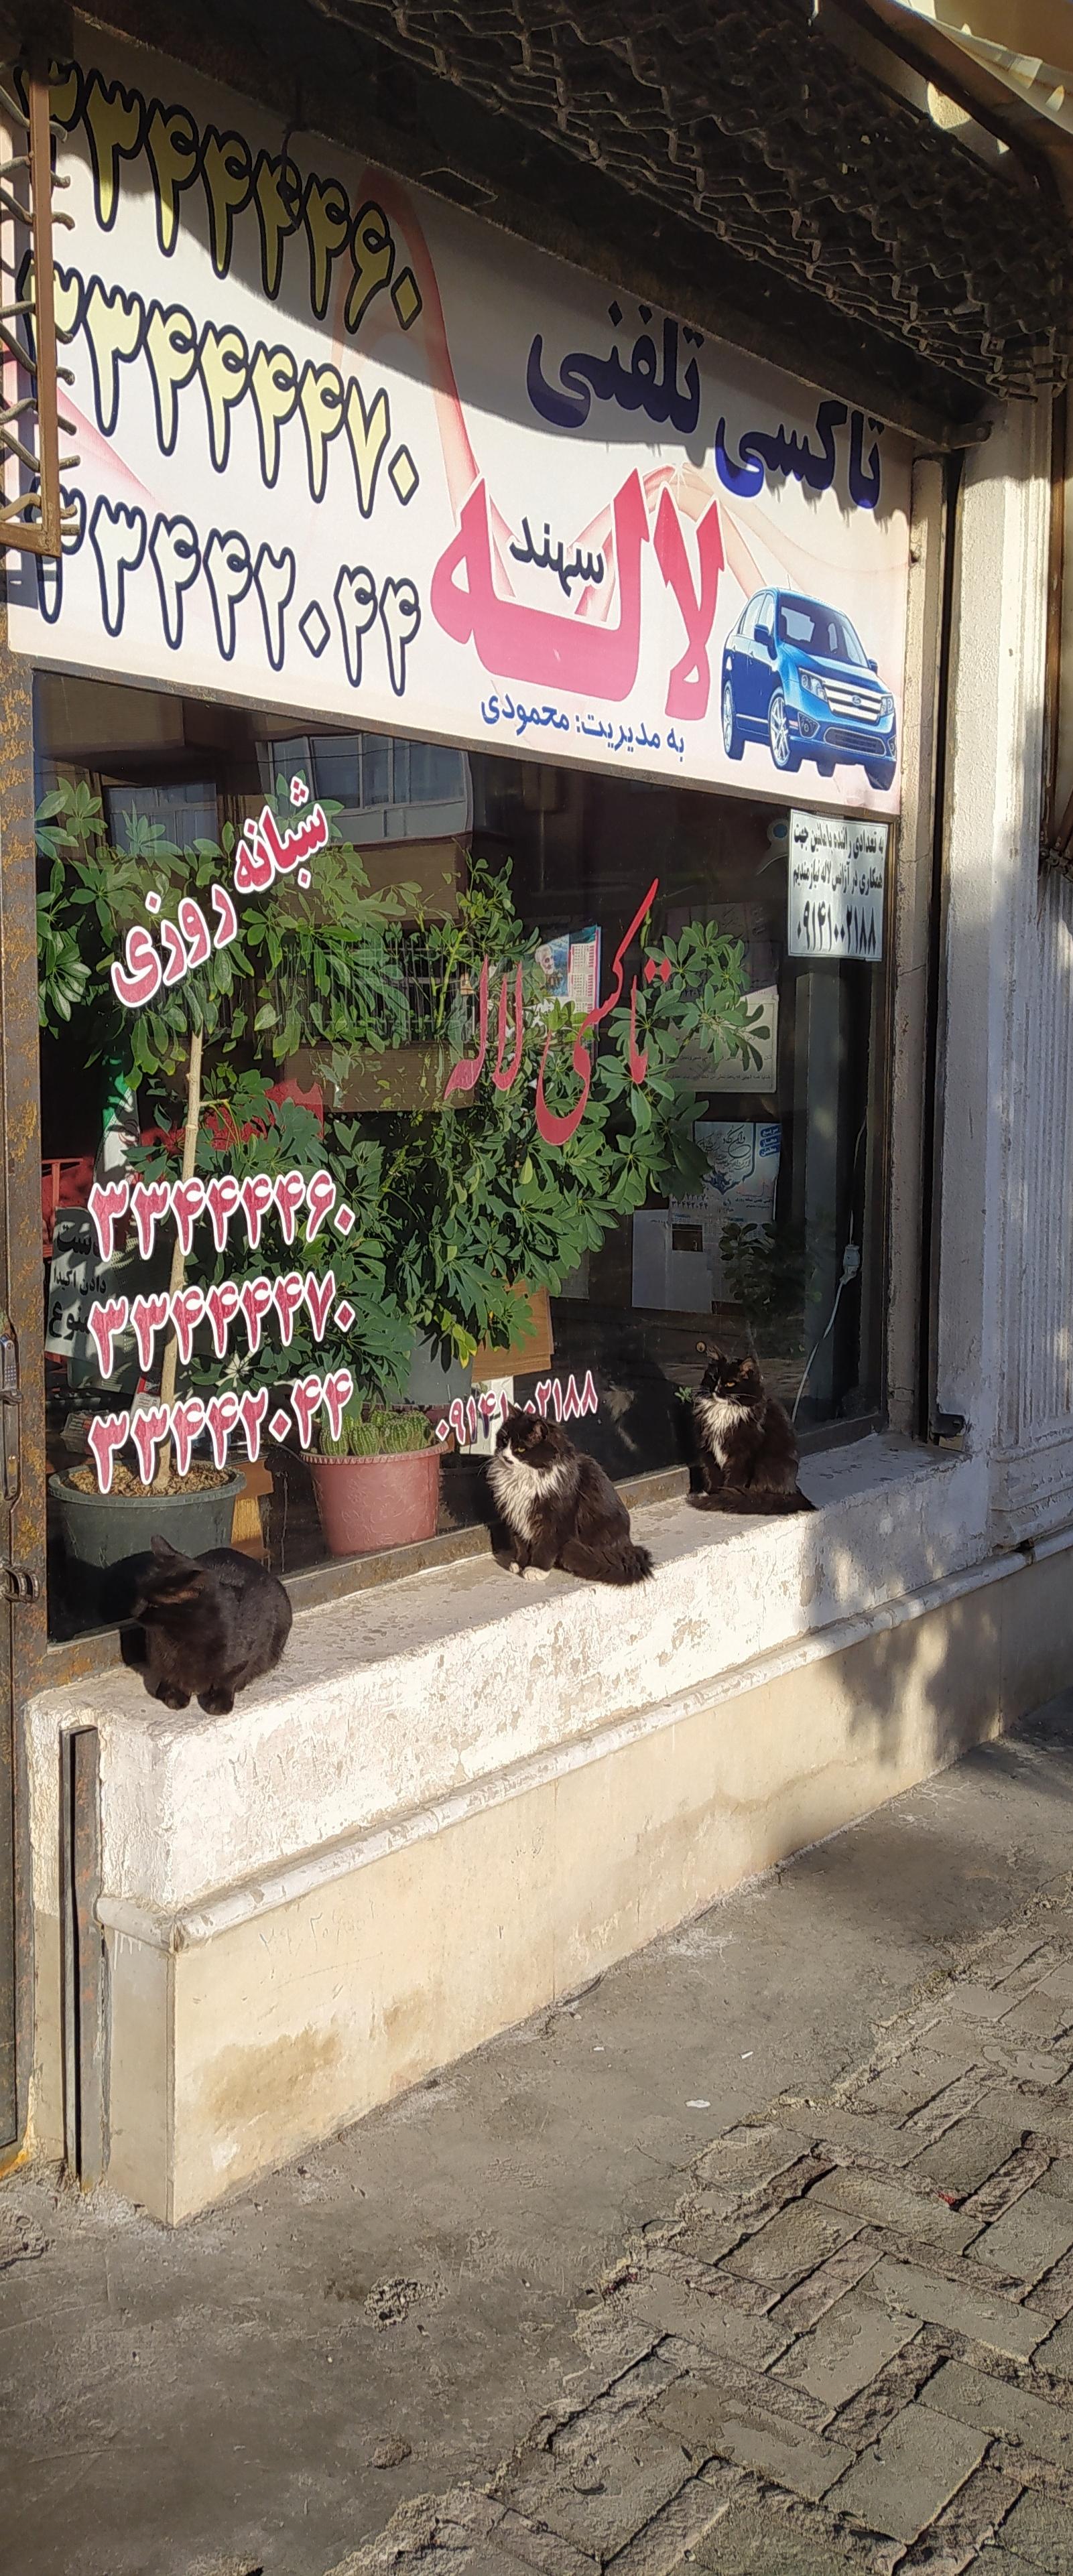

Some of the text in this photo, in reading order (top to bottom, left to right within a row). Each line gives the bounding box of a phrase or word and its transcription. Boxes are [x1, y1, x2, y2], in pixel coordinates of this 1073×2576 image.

[526, 300, 885, 510] تاکسی تلفنی
[430, 468, 725, 720] لاله
[509, 516, 605, 598] سهند
[481, 693, 570, 736] محمودی
[666, 727, 685, 762] به
[110, 775, 329, 1009] شبانه روزی
[797, 900, 877, 955] ۰۹۱۴۱۰۰۲۱۸۸
[88, 1170, 356, 1262] ۳۳۴۴۴۴۶۰
[88, 1270, 356, 1379] ۳۳۴۴۴۴۷۰
[88, 1369, 354, 1495] ۳۳۴۴۲۰۴۴
